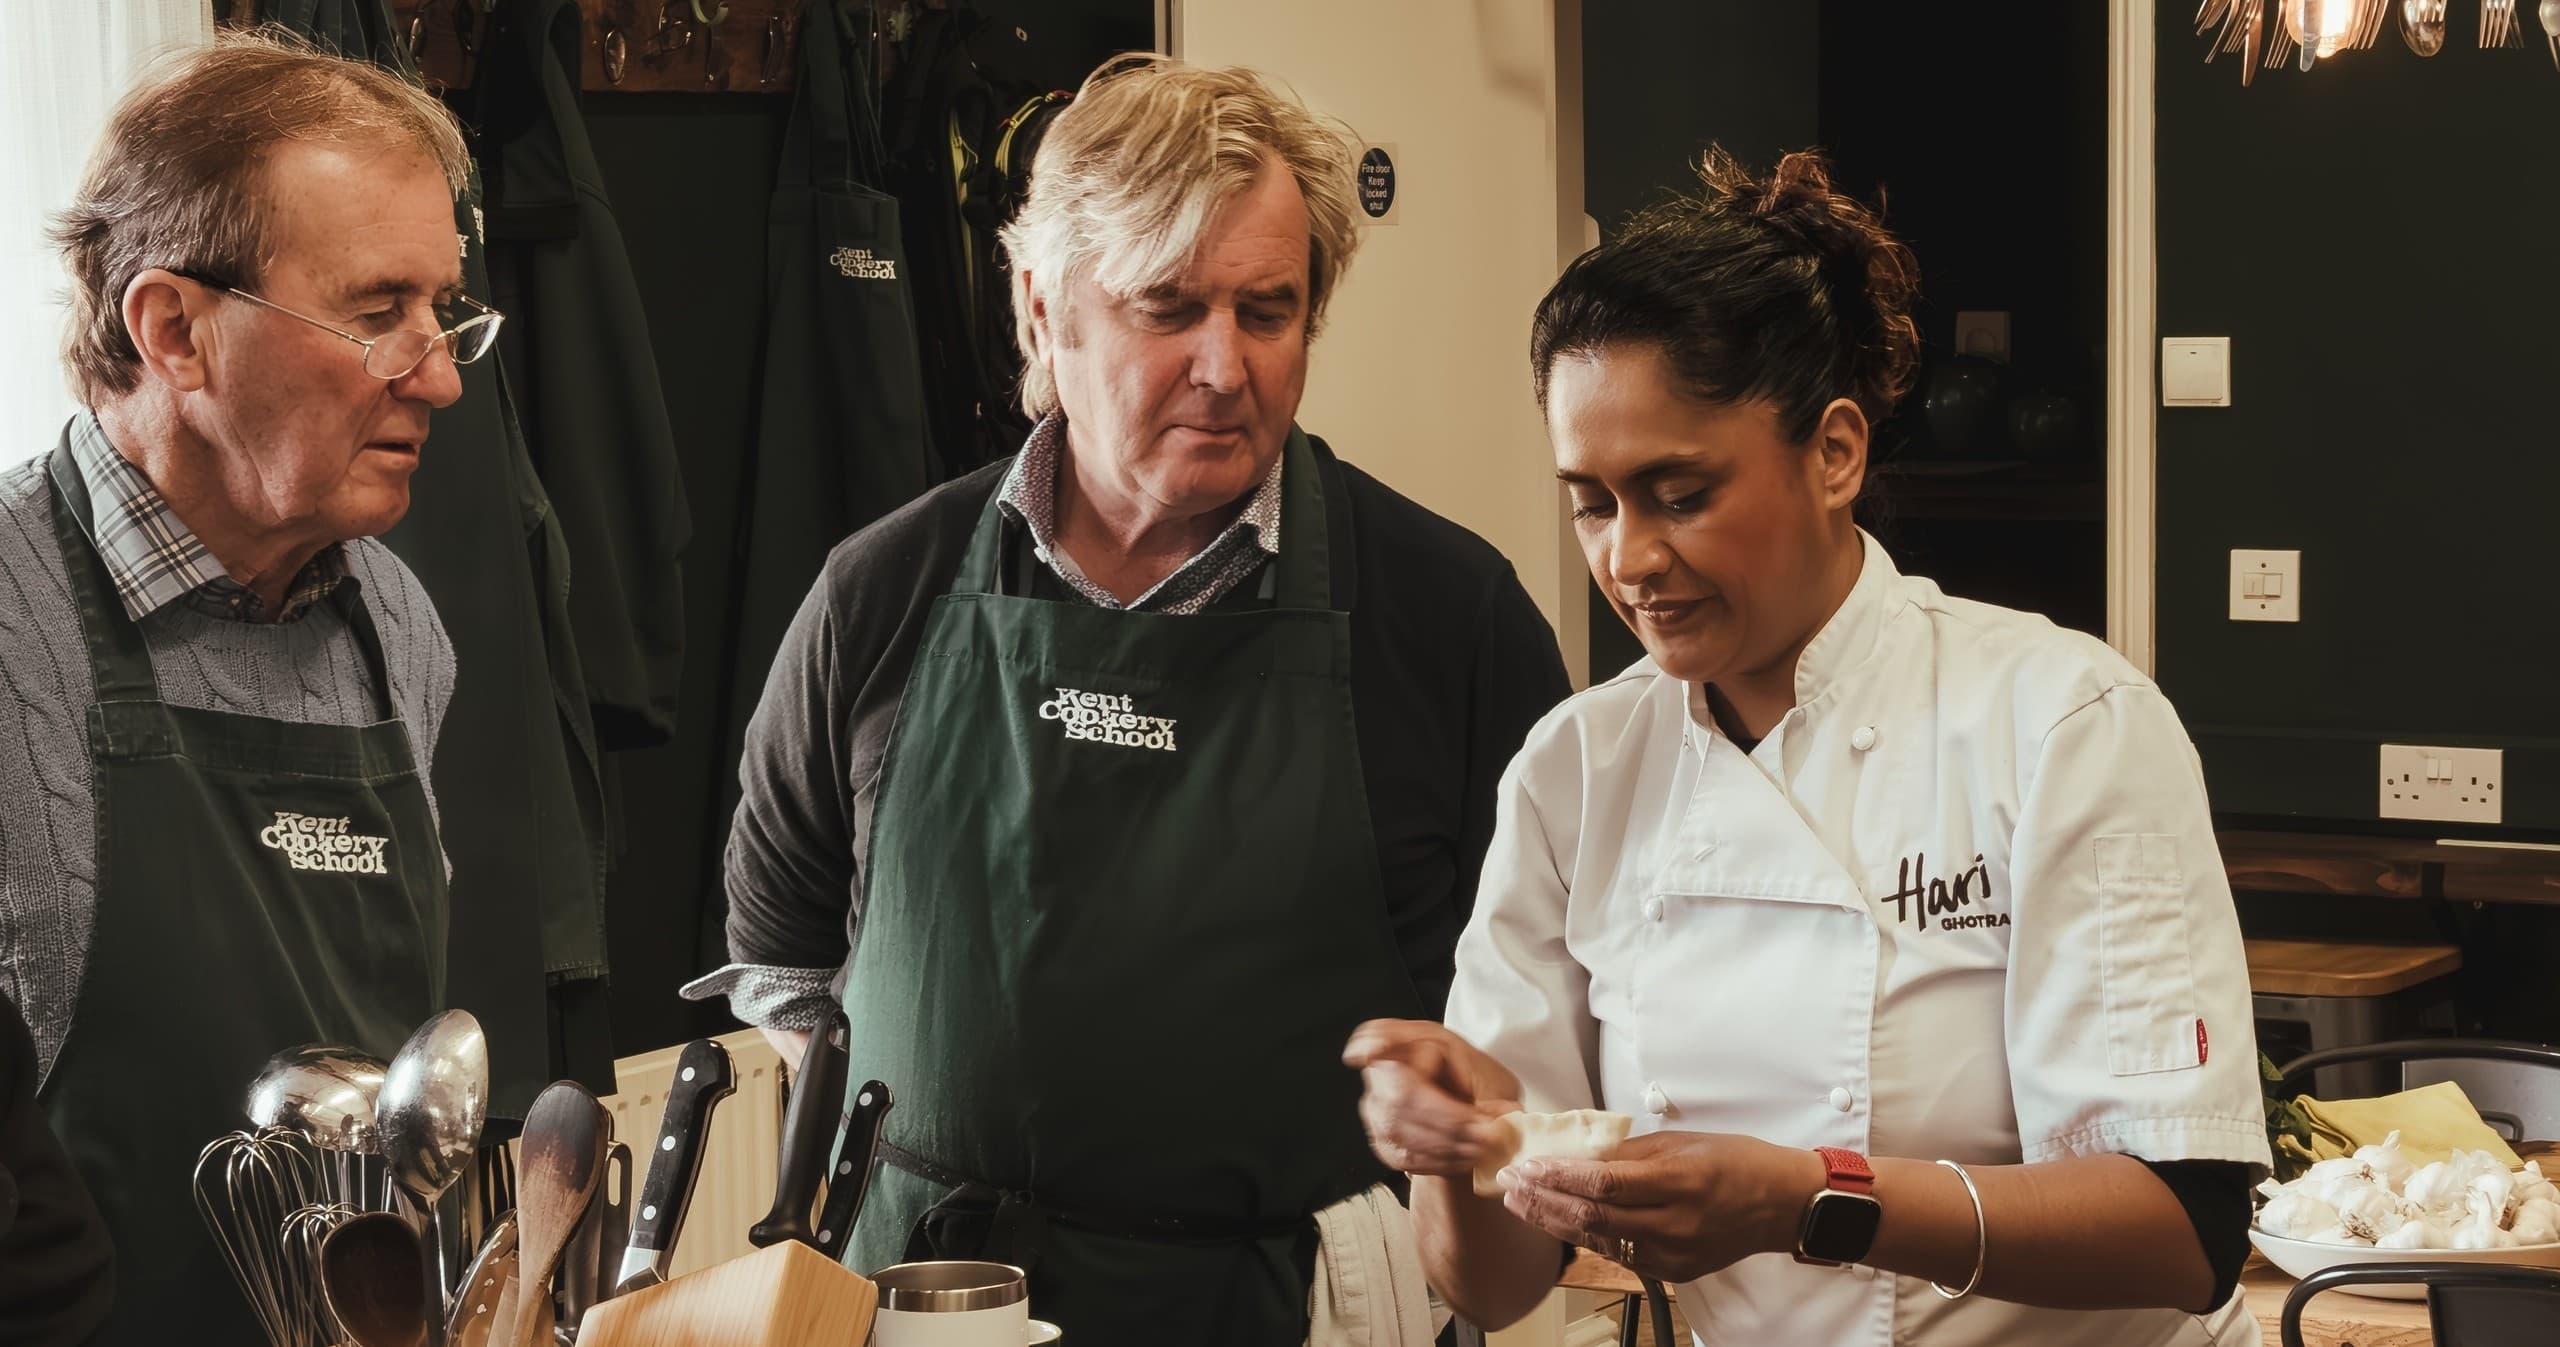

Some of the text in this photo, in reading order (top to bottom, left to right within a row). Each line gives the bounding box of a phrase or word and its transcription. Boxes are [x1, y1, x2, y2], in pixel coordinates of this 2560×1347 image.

[1362, 163, 1390, 173] Fire door
[1368, 176, 1385, 187] Keep
[1366, 188, 1387, 198] locked
[1369, 201, 1384, 211] shut
[830, 254, 895, 269] Cookery
[837, 247, 873, 259] Kent
[841, 266, 896, 279] School
[1055, 687, 1133, 713] Kent
[1039, 700, 1177, 736] Cookery
[1065, 720, 1177, 751] School
[274, 811, 350, 834] Kent
[261, 825, 389, 858] Cookery
[288, 849, 388, 874] School
[1881, 852, 1991, 932] Hari
[1941, 913, 2011, 931] GHOTRA
